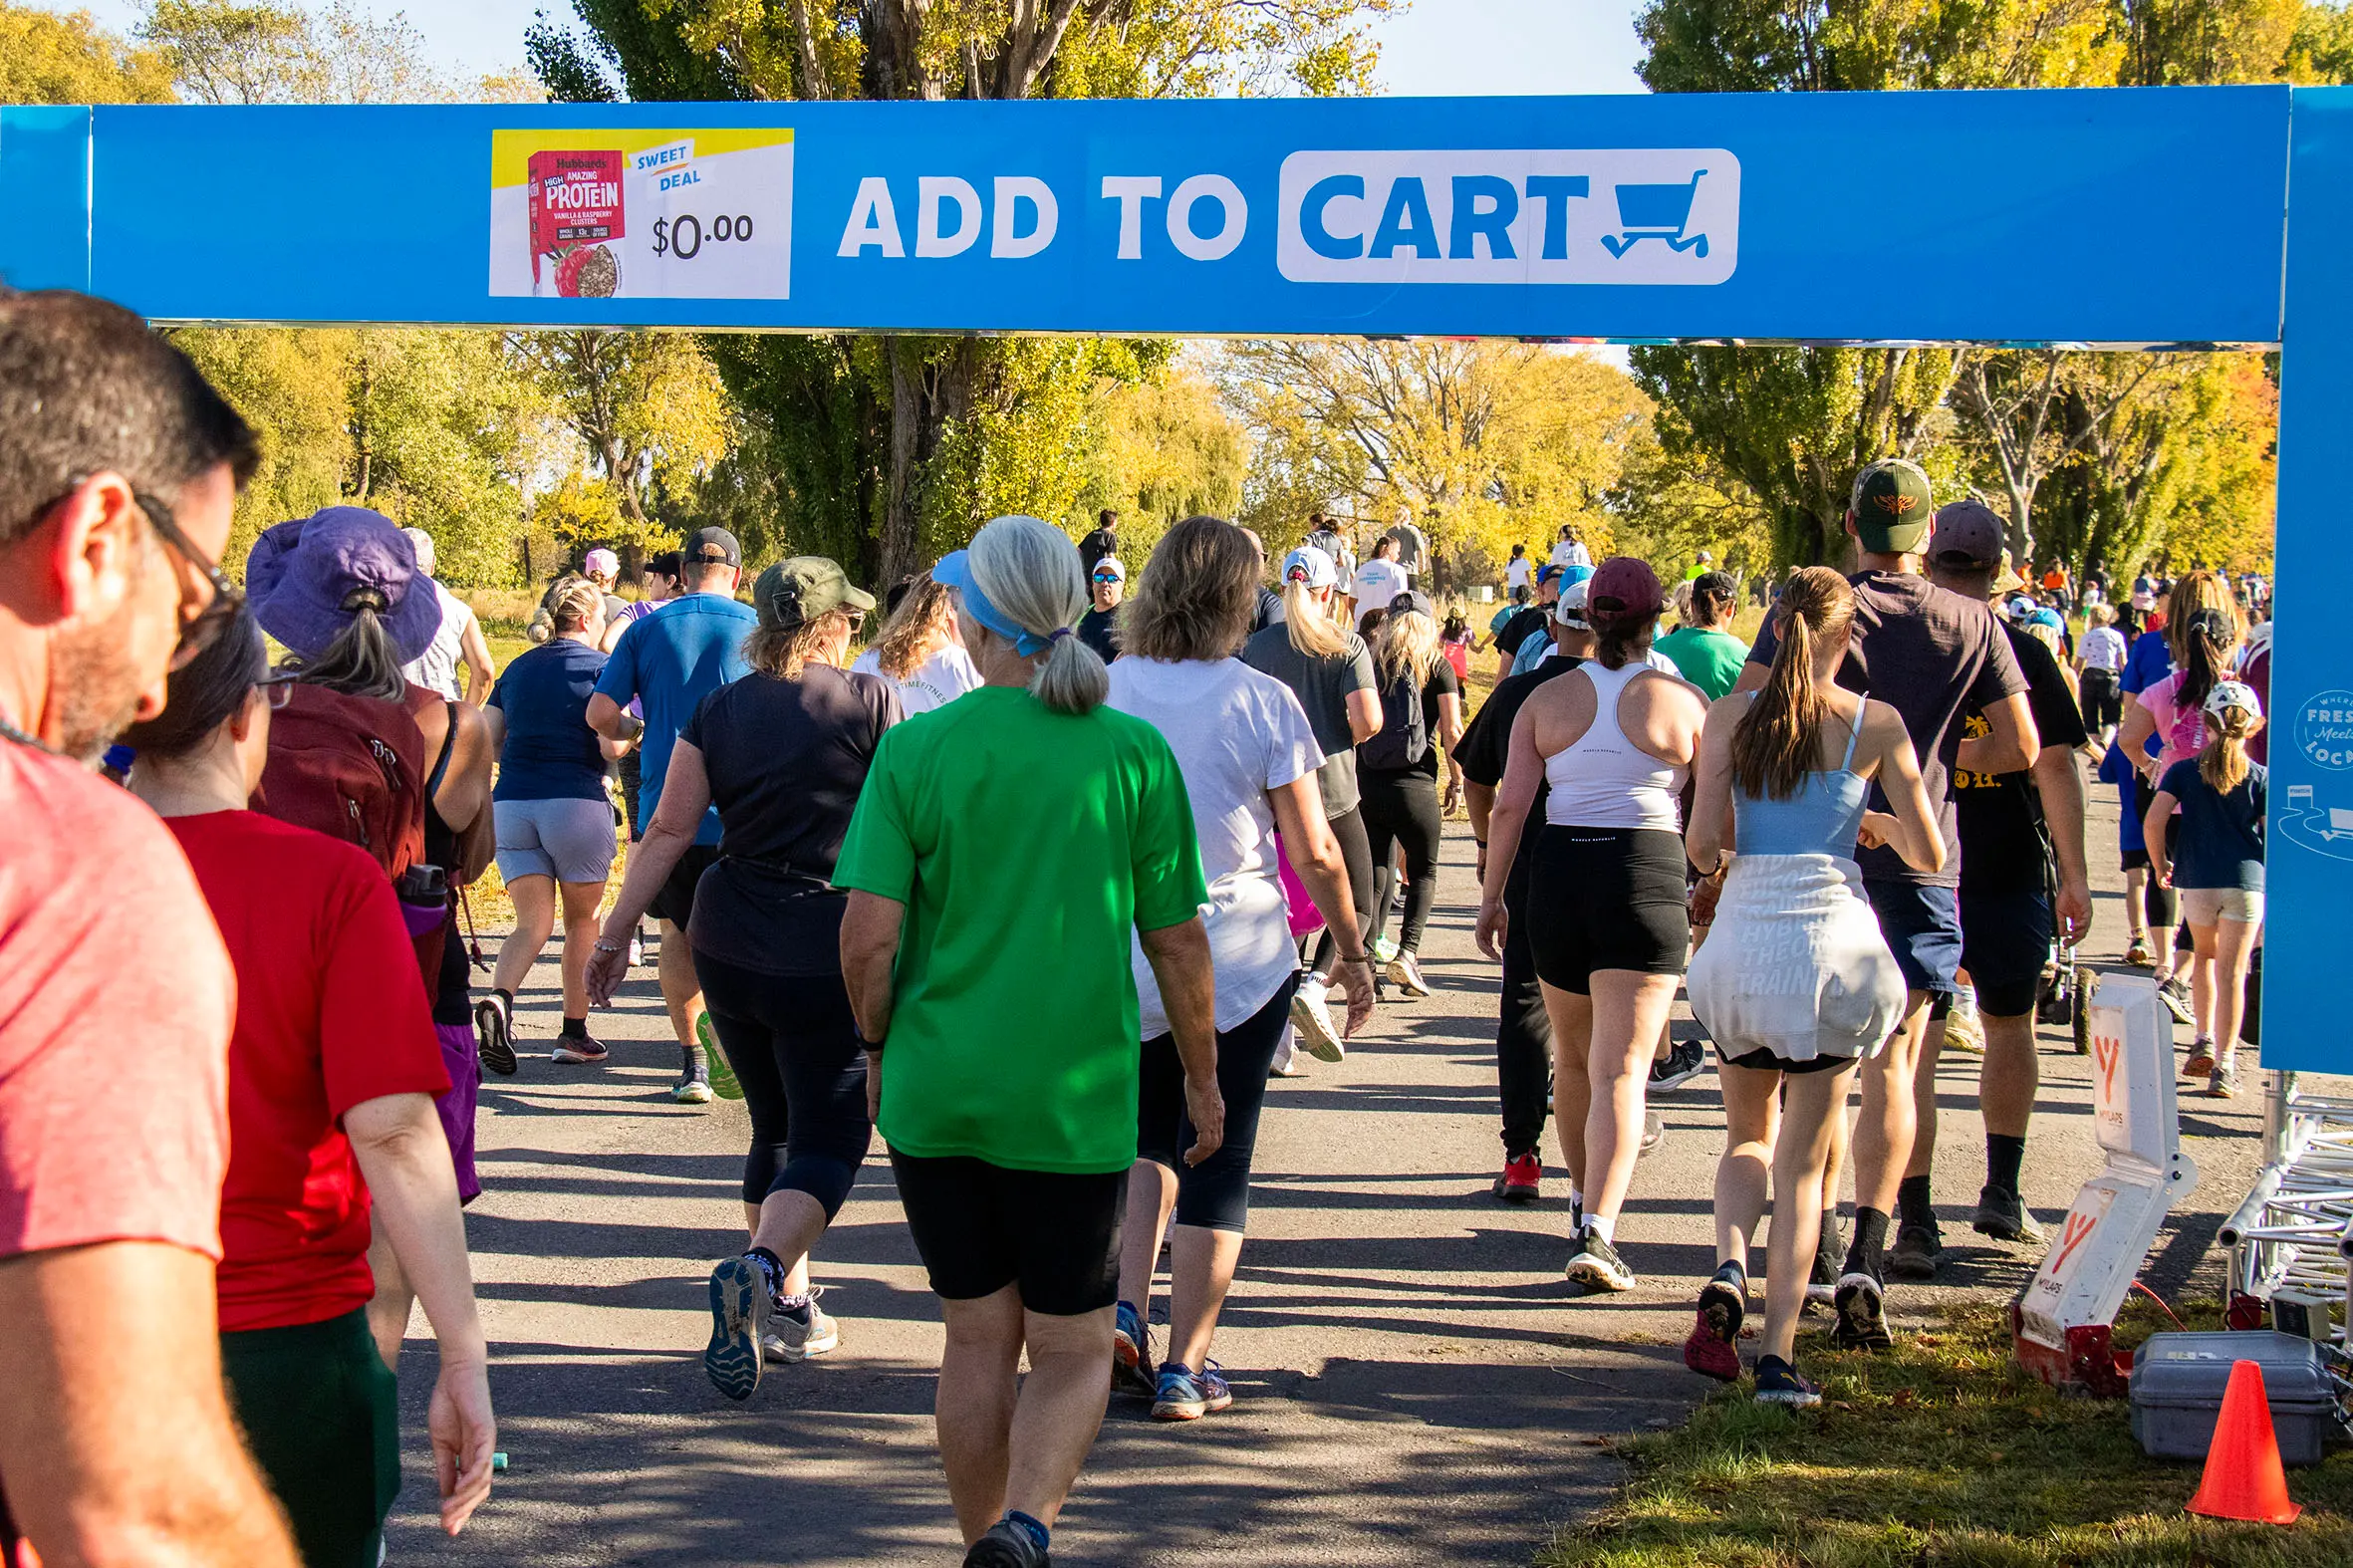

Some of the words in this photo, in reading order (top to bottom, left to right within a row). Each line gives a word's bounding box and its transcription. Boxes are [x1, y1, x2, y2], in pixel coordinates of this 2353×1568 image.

[556, 158, 607, 169] Hubbards
[638, 146, 686, 170] SWEET
[567, 171, 598, 181] AMAZING
[660, 170, 701, 192] DEAL
[837, 175, 1059, 260] ADD
[1102, 174, 1248, 261] TO
[1299, 174, 1590, 261] CART
[652, 215, 753, 260] $0.00
